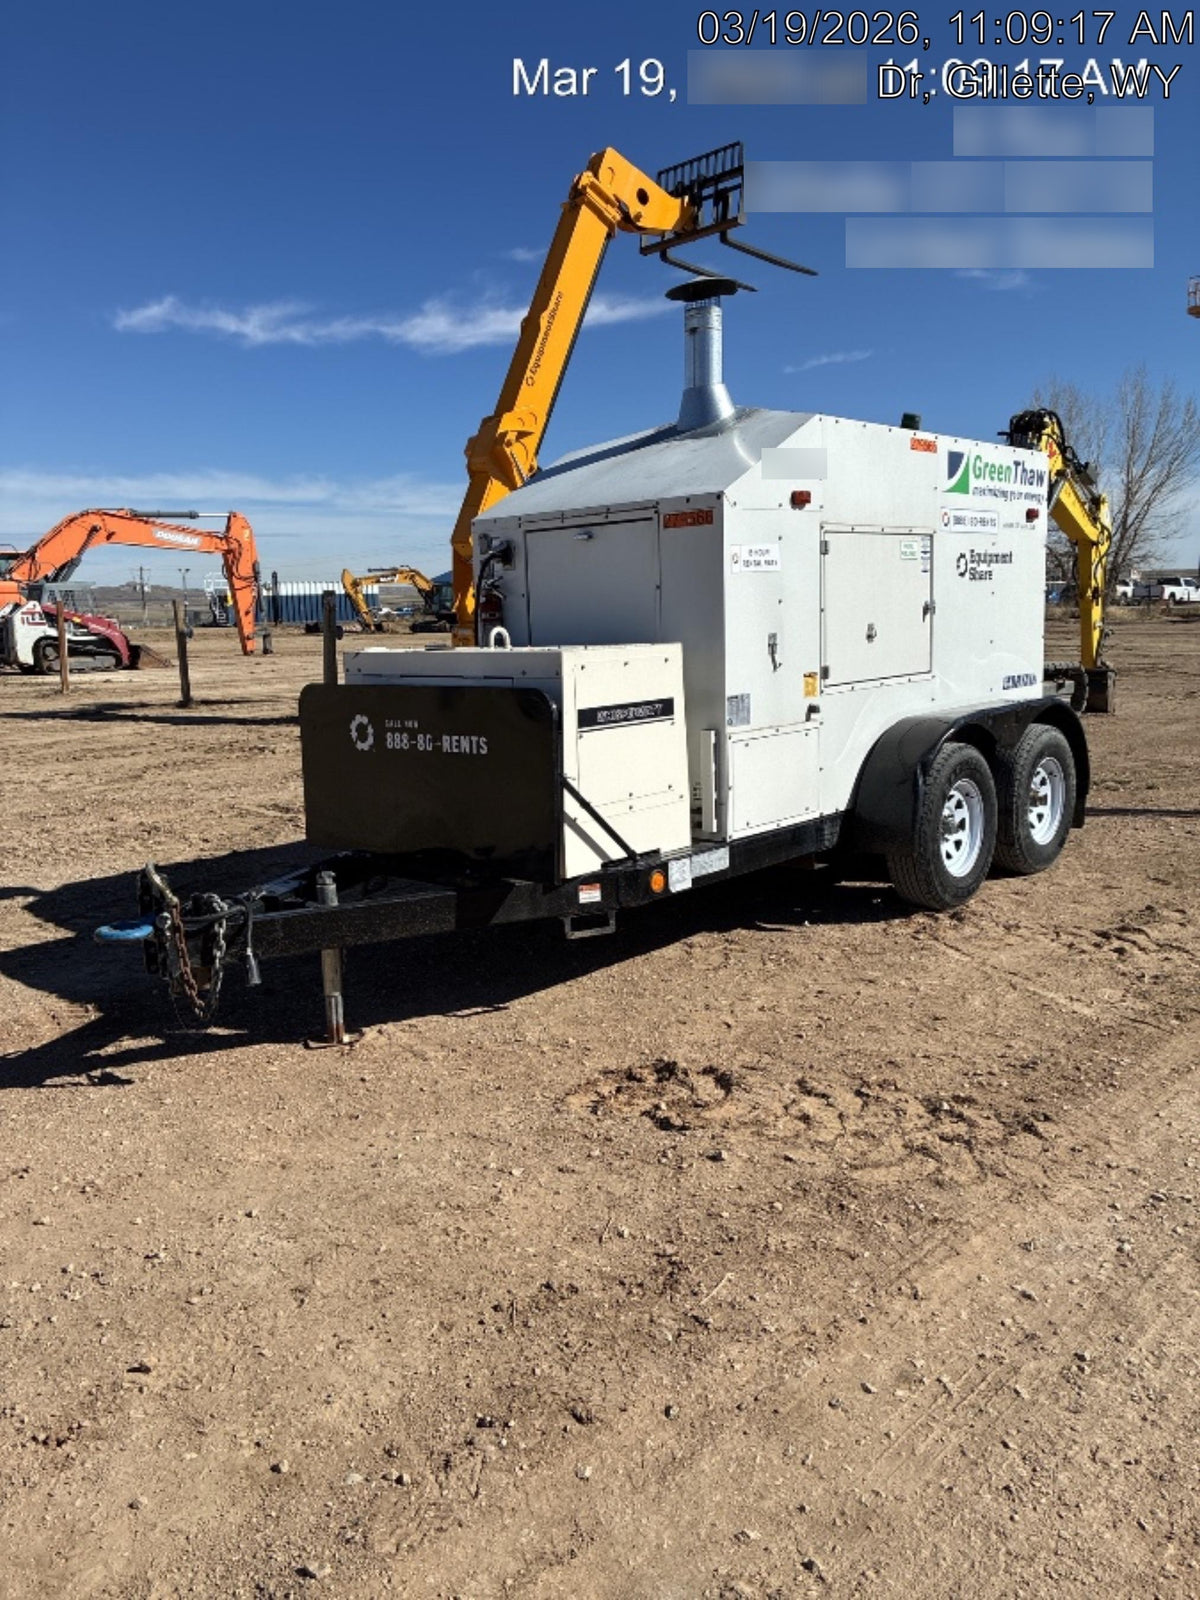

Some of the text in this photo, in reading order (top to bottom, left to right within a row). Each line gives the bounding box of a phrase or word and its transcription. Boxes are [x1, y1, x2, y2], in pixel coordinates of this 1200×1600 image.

[973, 454, 1046, 488] GreenThaw
[969, 549, 1012, 567] Equipment
[969, 566, 993, 580] Share
